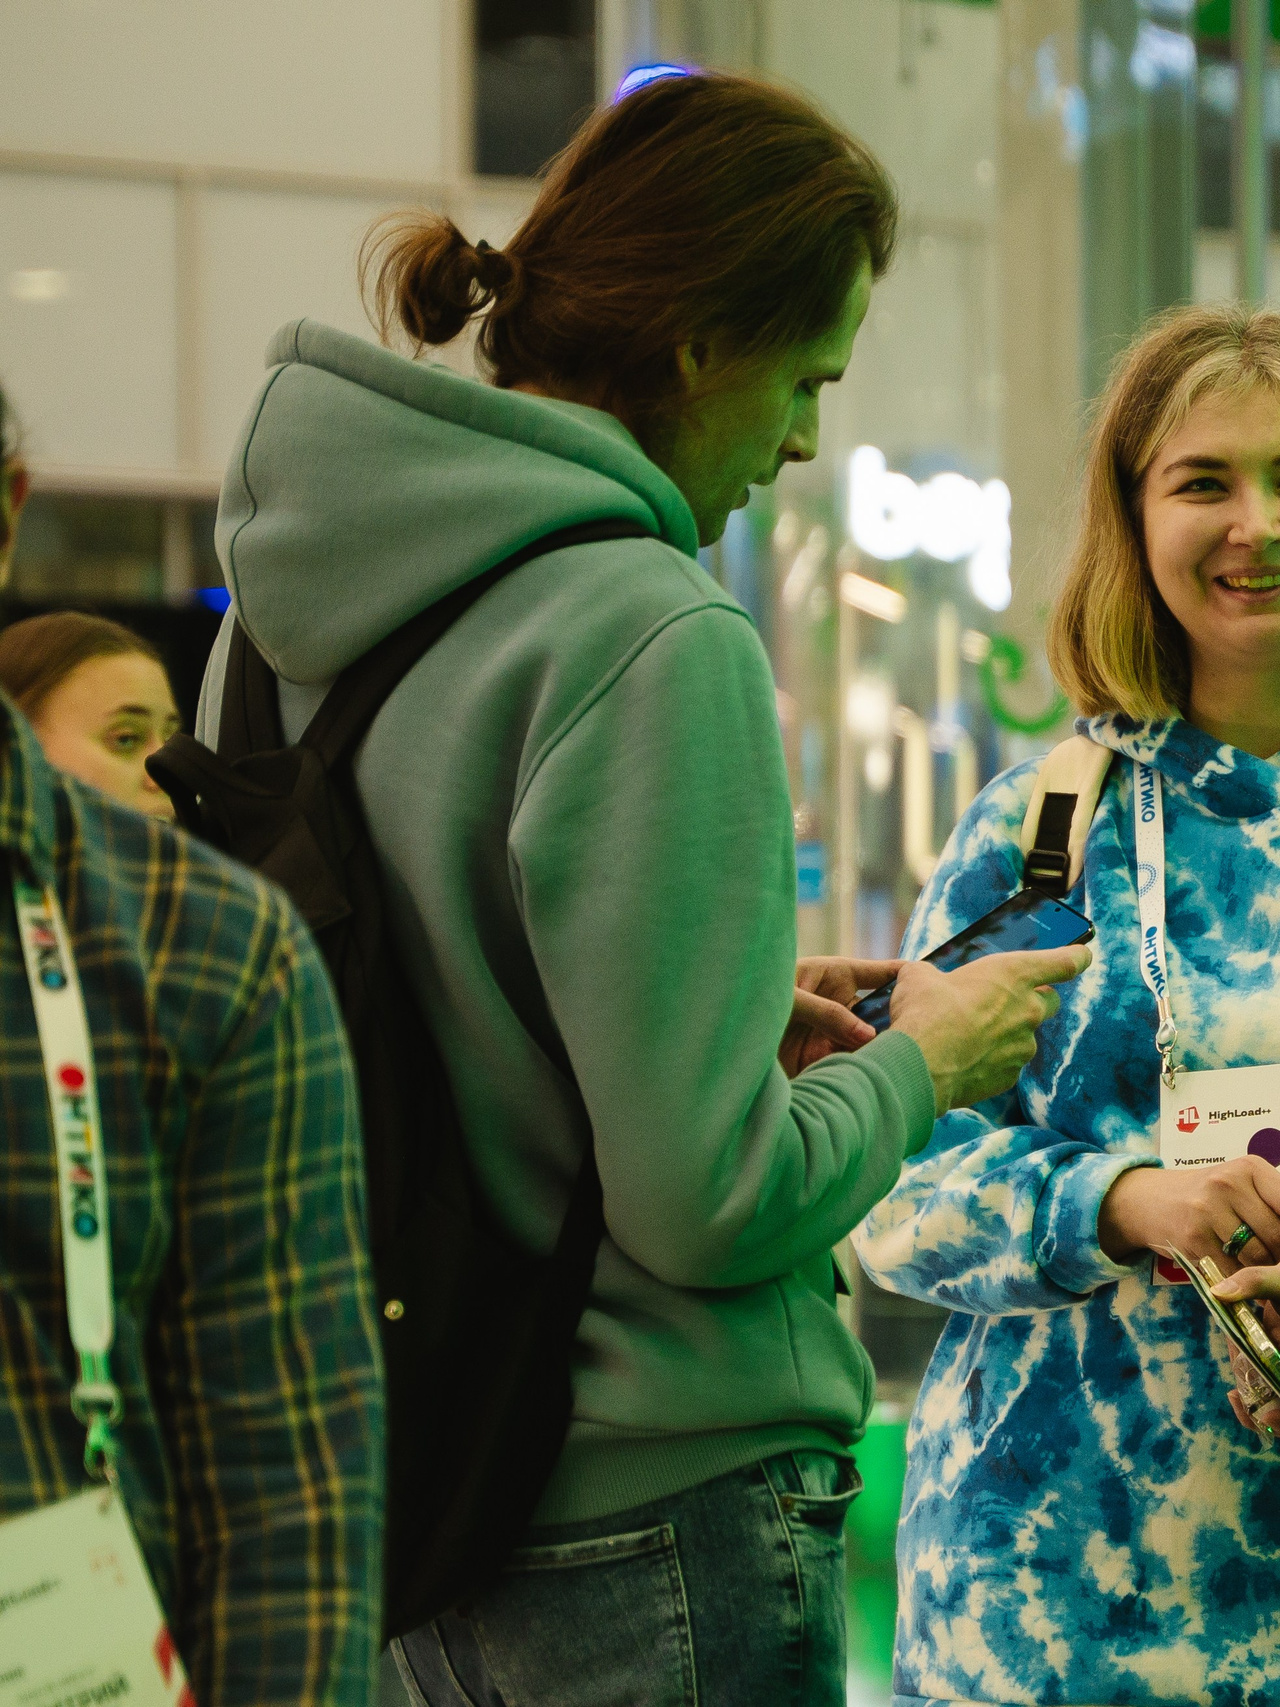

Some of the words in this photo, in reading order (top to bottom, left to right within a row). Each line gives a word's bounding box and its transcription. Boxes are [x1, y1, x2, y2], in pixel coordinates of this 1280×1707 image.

[1139, 762, 1156, 823] НТИКО
[1208, 1107, 1272, 1121] HighLoad++
[1174, 1156, 1226, 1167] Участник
